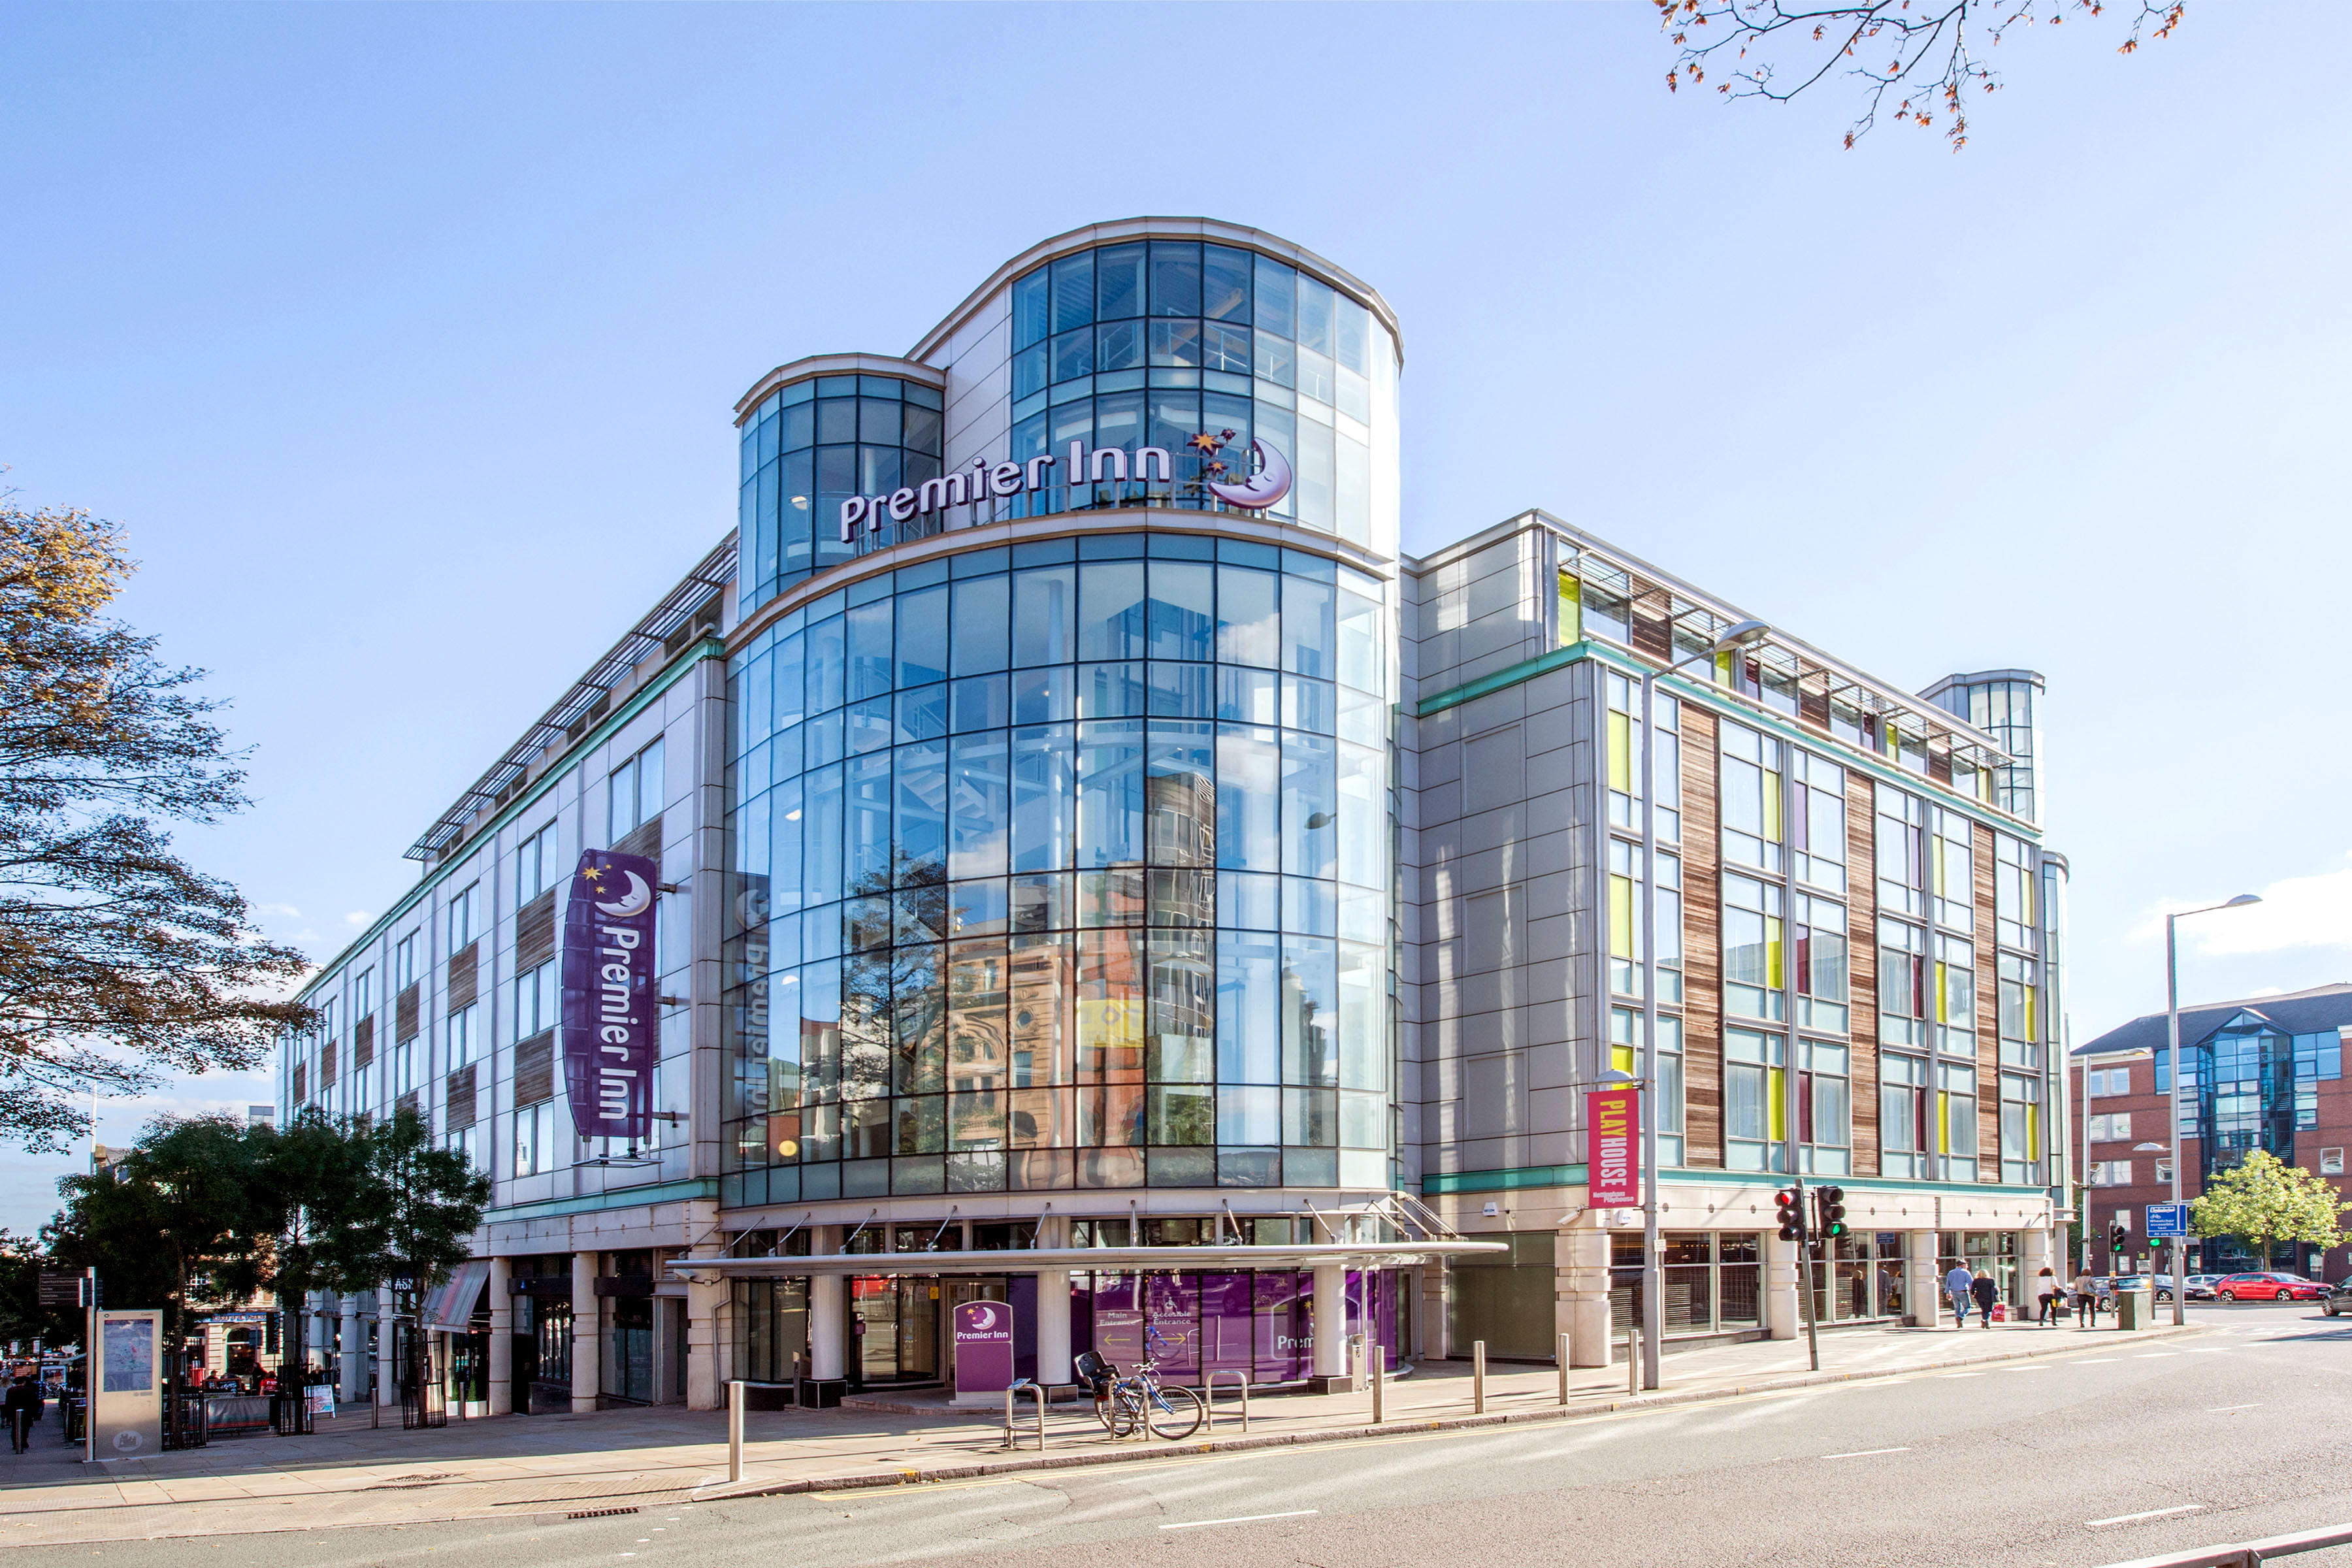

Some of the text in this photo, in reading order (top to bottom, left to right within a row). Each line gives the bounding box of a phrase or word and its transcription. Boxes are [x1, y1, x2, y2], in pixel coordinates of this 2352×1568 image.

[841, 440, 1171, 544] Premier Inn
[599, 926, 640, 1120] Premier Inn
[1600, 1100, 1627, 1187] PLAYHOUSE
[956, 1331, 993, 1339] Premier
[1277, 1335, 1315, 1349] Prem
